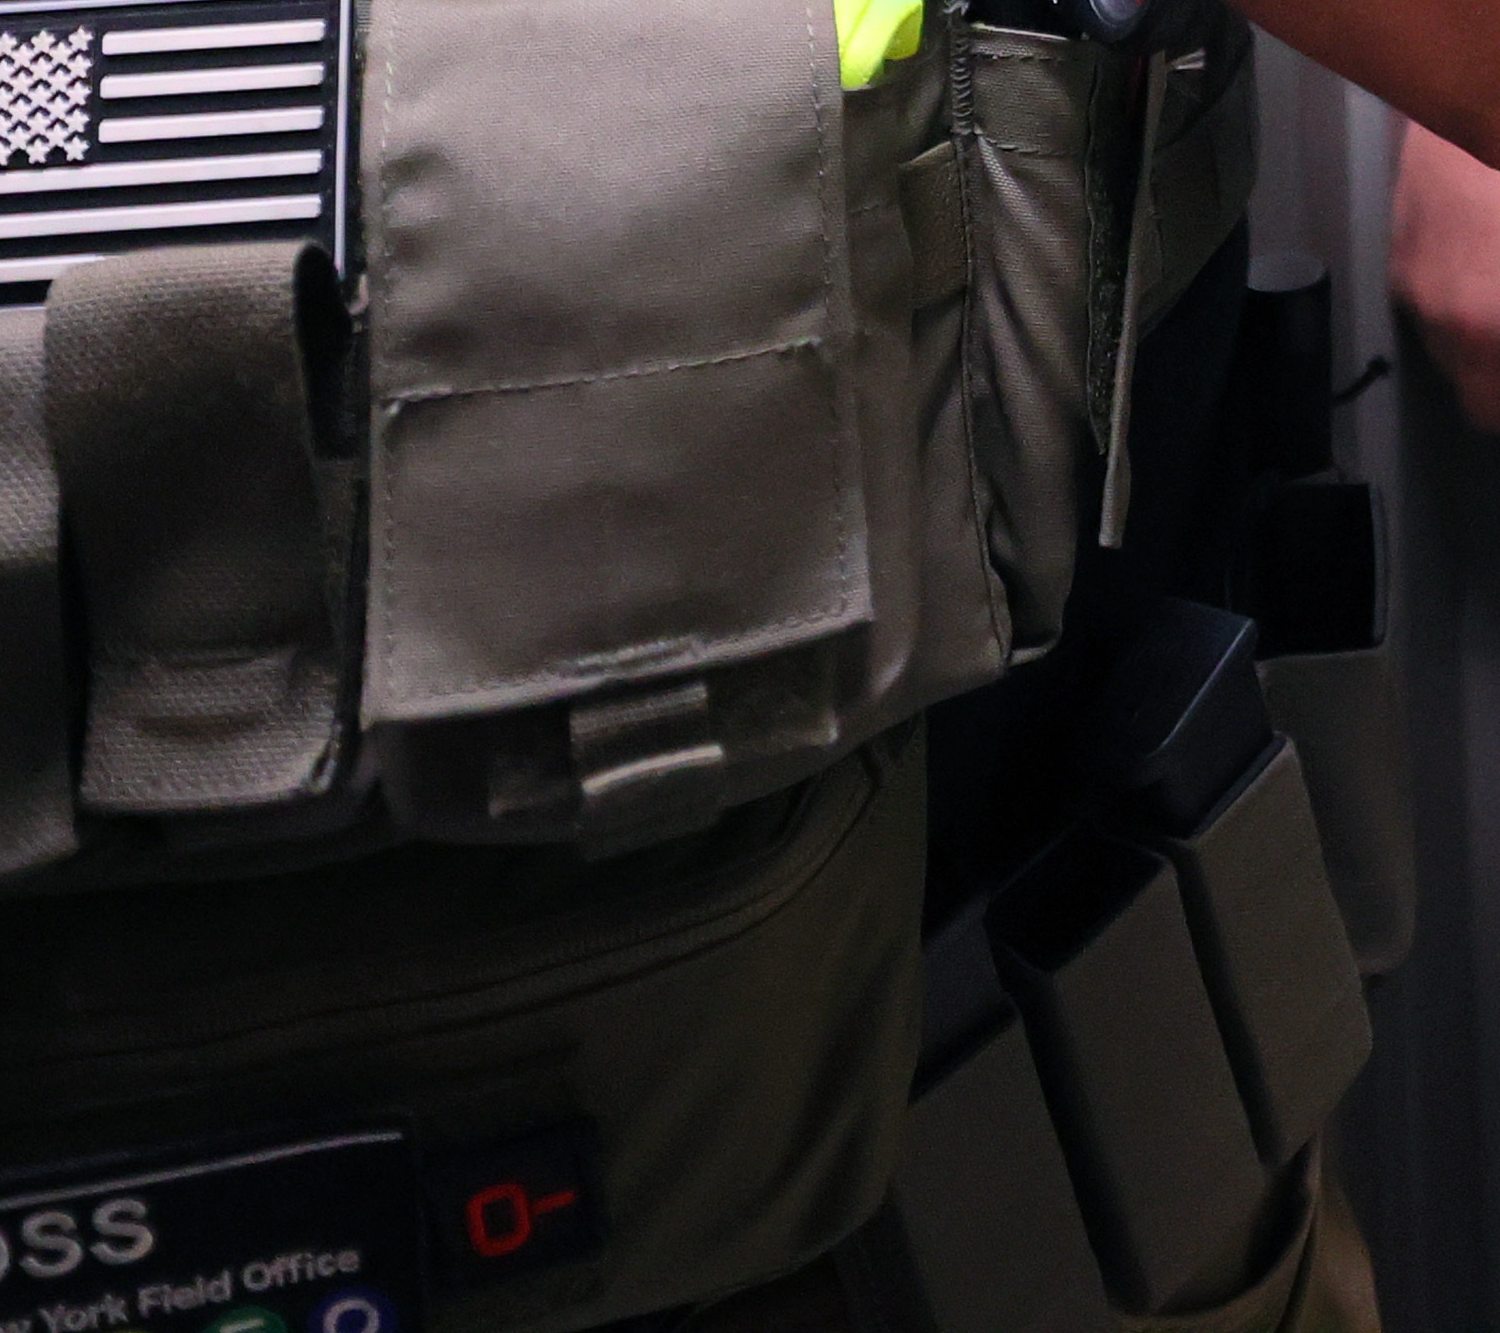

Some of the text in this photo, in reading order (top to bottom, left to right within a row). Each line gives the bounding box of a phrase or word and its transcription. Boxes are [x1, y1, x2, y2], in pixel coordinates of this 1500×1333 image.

[37, 1247, 363, 1333] York Field Office
